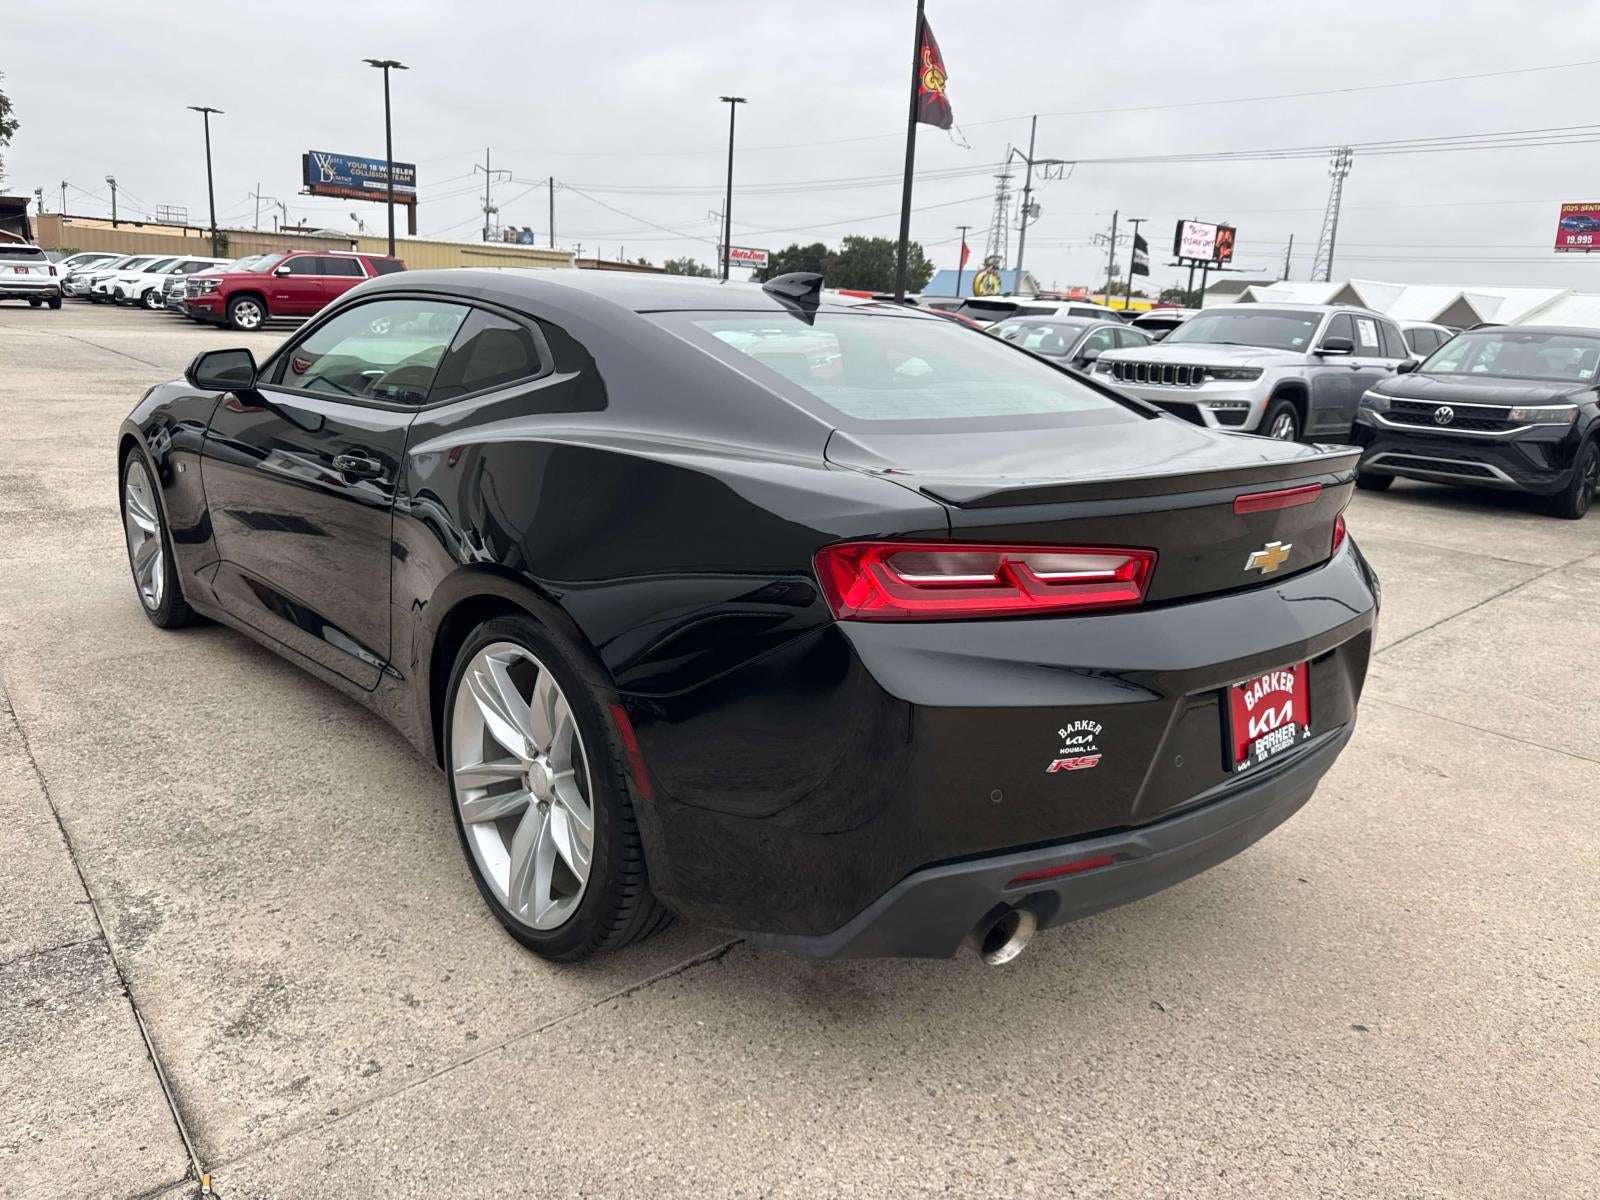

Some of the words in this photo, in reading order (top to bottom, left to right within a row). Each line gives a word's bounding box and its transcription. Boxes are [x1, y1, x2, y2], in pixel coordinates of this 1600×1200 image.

[347, 161, 367, 169] YOUR
[379, 165, 414, 176] WEELER
[1566, 235, 1592, 245] 19,995
[1244, 671, 1294, 712] BARKER
[1058, 720, 1102, 739] BARKER
[1255, 722, 1296, 755] BARKER
[1045, 753, 1103, 773] RS
